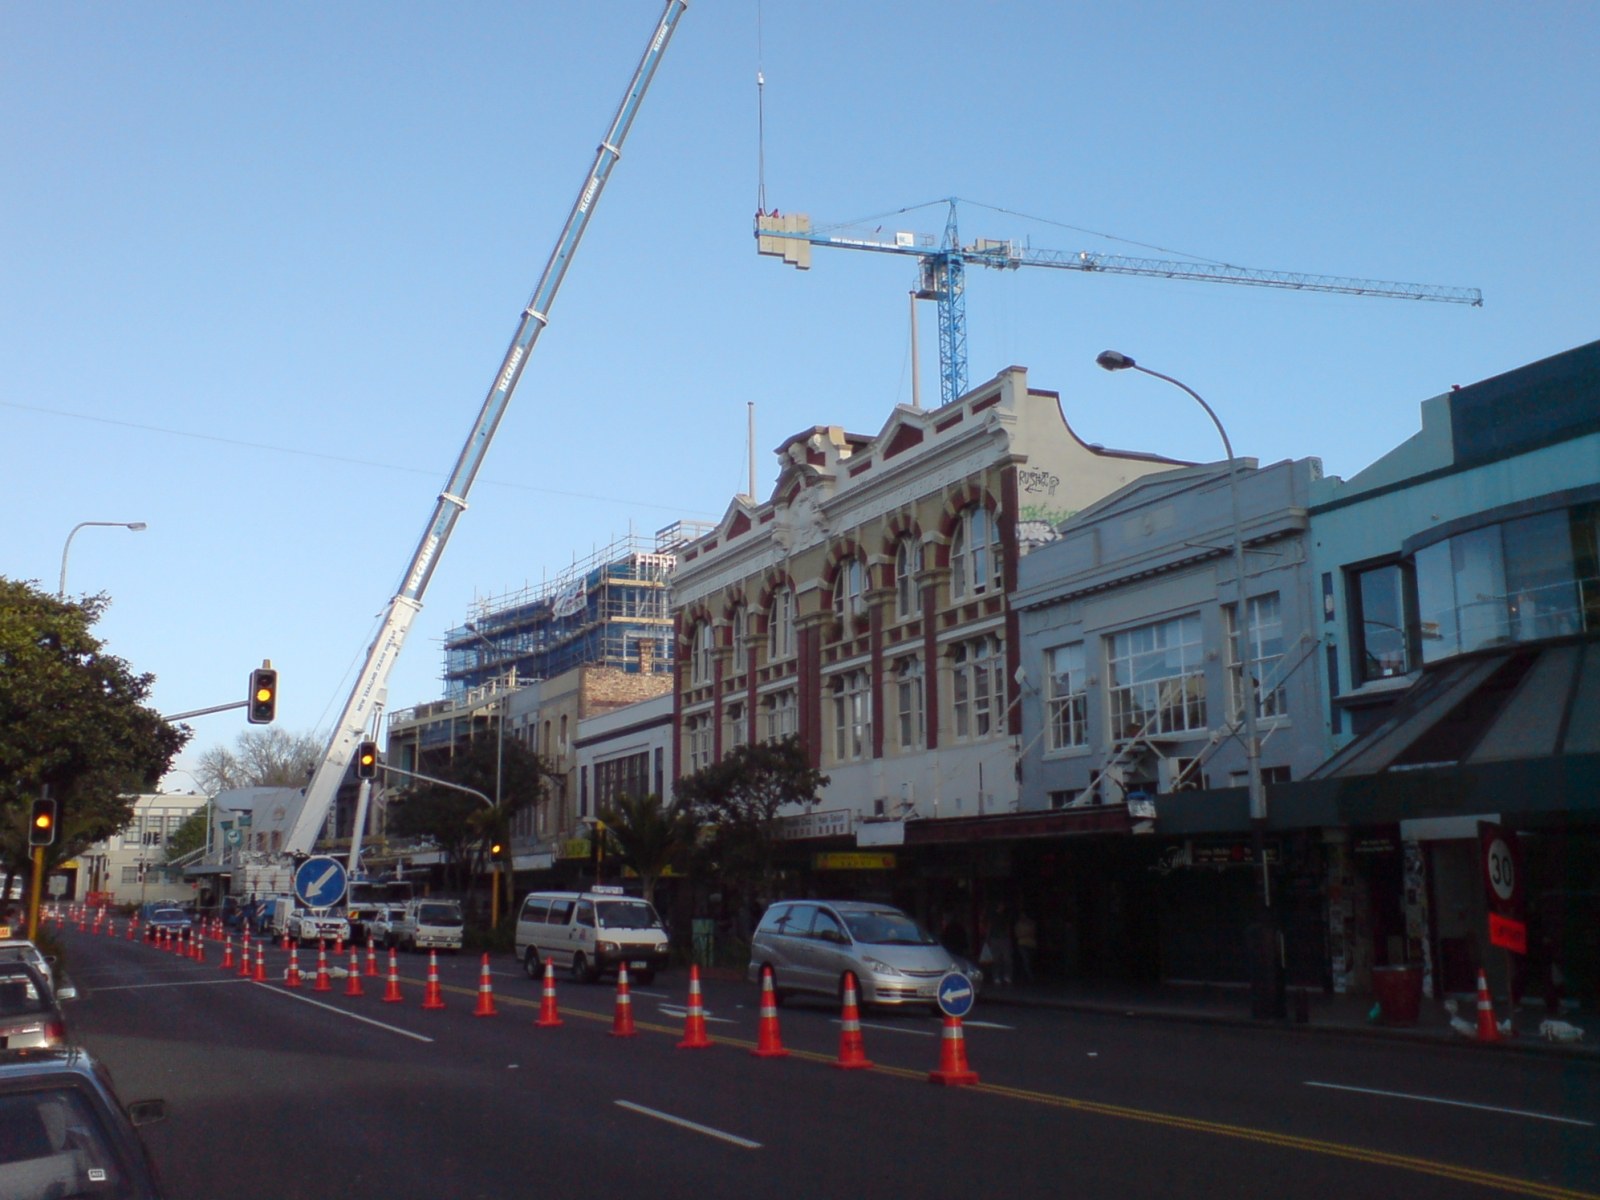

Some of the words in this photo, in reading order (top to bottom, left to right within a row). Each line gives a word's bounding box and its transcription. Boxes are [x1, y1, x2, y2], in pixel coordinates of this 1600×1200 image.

[584, 176, 600, 203] CRANES
[498, 377, 510, 392] NZ
[505, 346, 523, 379] CRANES
[408, 574, 422, 591] NZ
[416, 534, 439, 576] CRANES
[1491, 853, 1512, 887] 30
